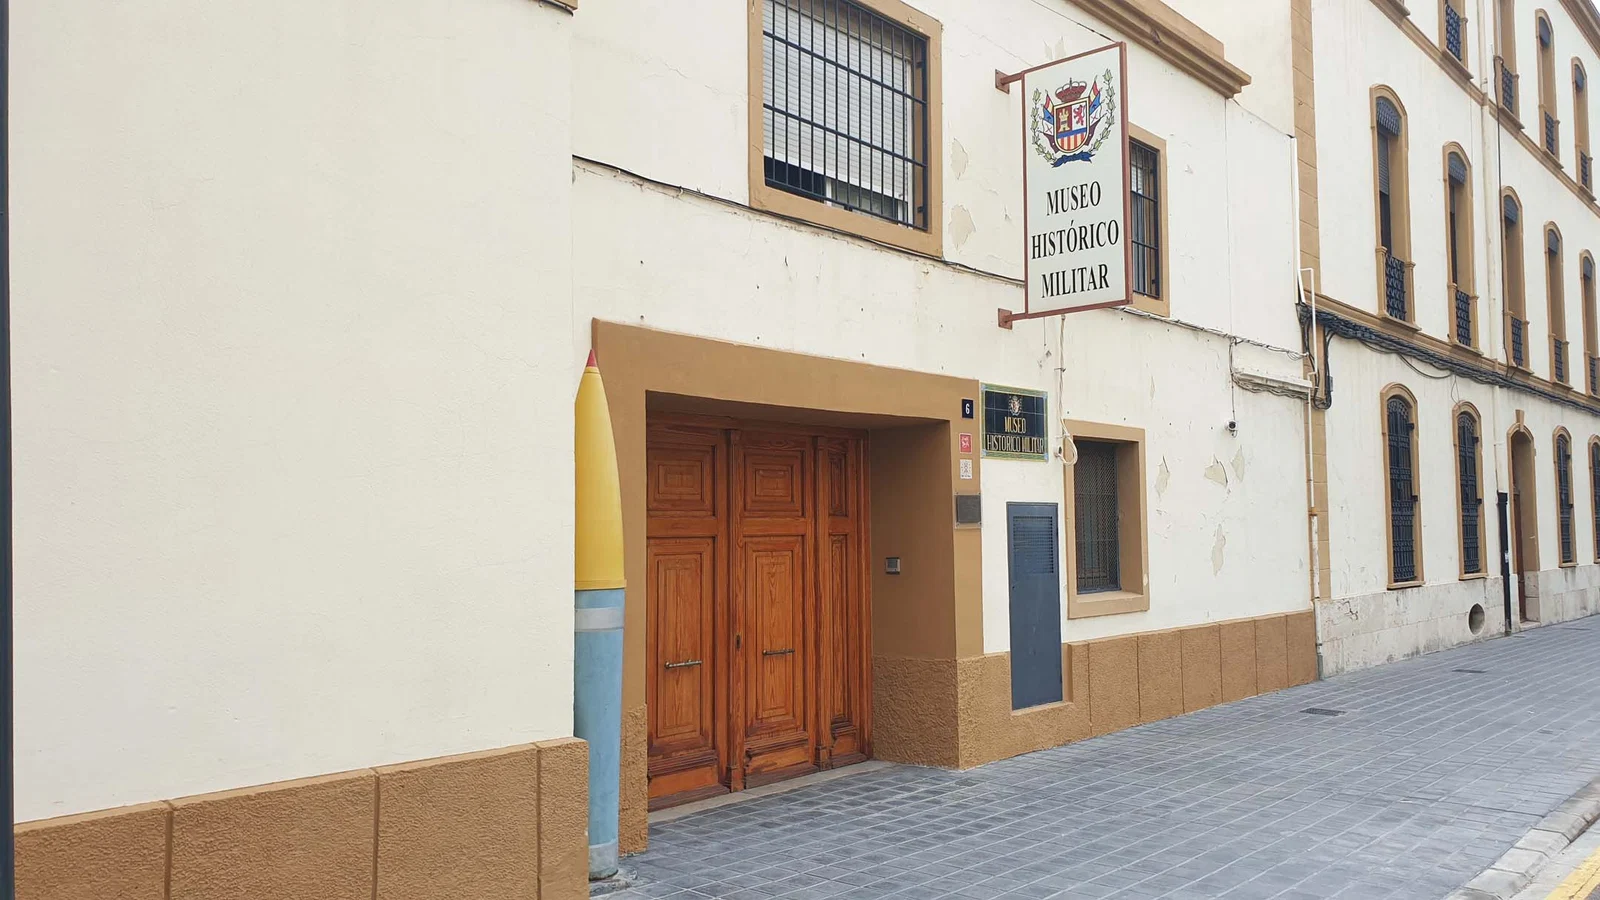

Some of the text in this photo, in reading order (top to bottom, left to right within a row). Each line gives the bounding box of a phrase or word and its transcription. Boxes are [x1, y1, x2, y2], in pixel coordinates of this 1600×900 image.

[1046, 181, 1101, 216] MUSEO
[1031, 219, 1119, 260] HISTÓRICO
[1041, 263, 1110, 298] MILITAR
[965, 403, 970, 415] 6
[1004, 416, 1027, 433] MUSEO
[1021, 437, 1044, 453] MILITAR
